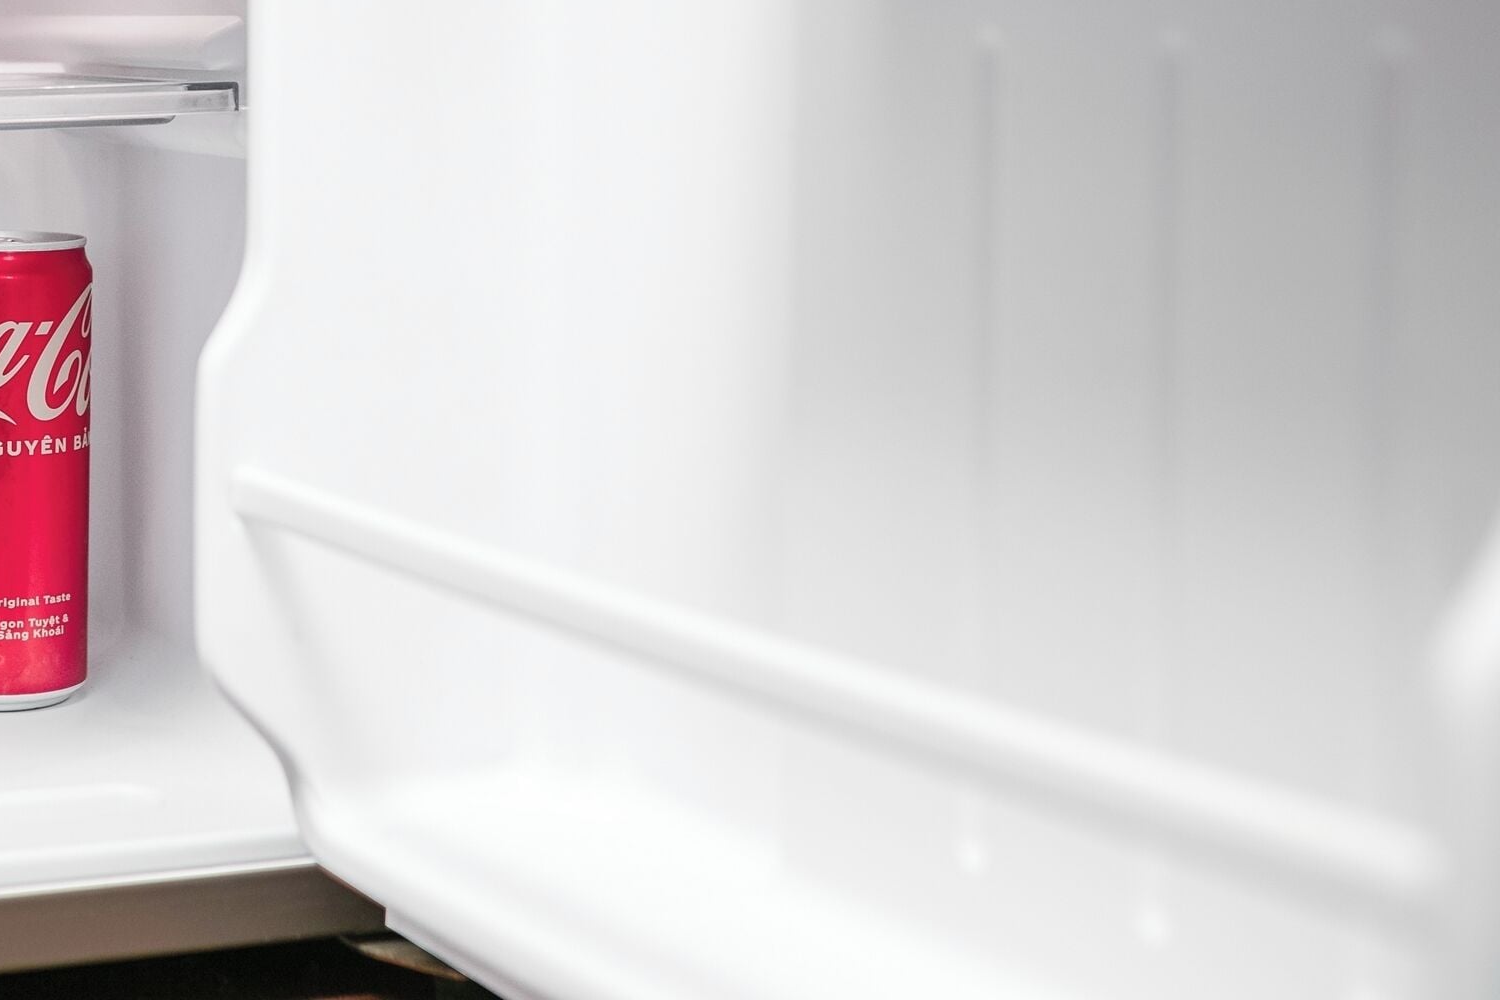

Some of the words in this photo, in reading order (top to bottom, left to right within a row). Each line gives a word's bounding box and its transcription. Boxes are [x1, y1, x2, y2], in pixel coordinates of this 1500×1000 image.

[43, 593, 71, 605] Taste
[28, 615, 60, 627] Tuyệt
[33, 625, 64, 638] Khoái
